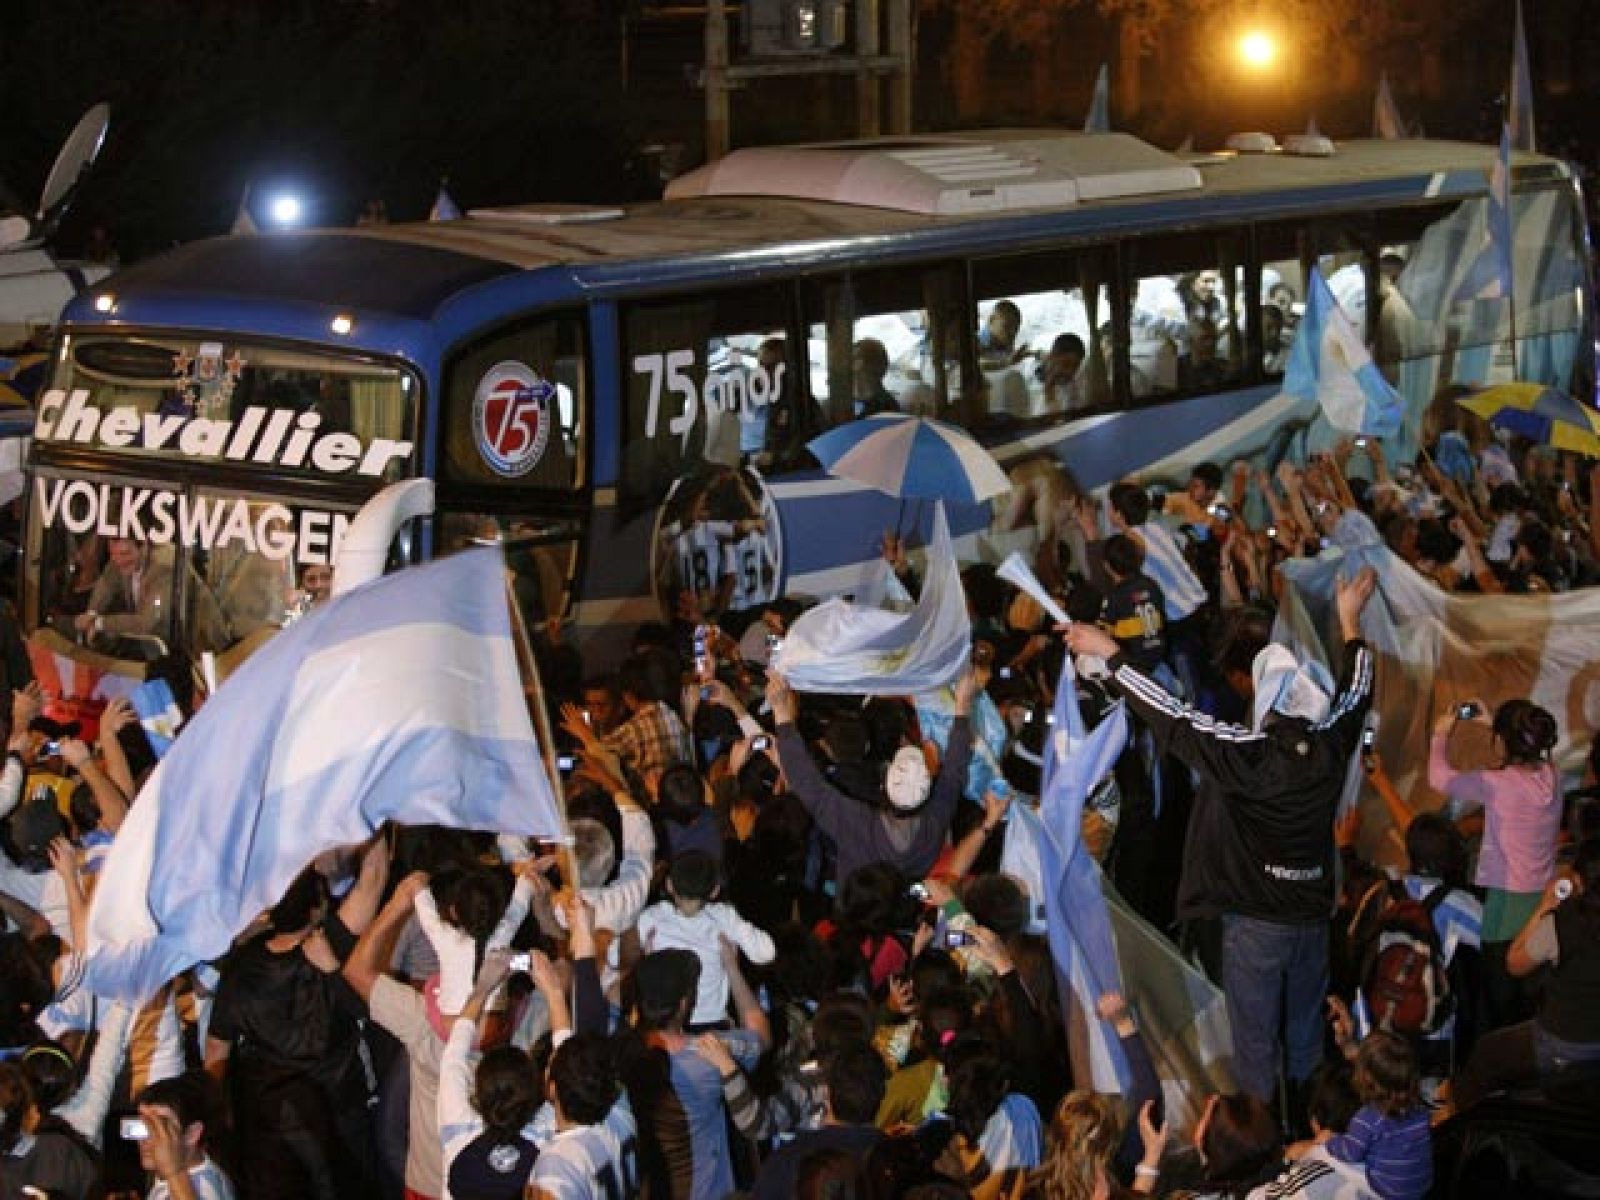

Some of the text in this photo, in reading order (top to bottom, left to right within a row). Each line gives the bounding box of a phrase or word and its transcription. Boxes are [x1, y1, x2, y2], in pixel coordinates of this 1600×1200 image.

[34, 388, 414, 476] Chevallier
[486, 389, 540, 459] 75
[633, 349, 698, 438] 75
